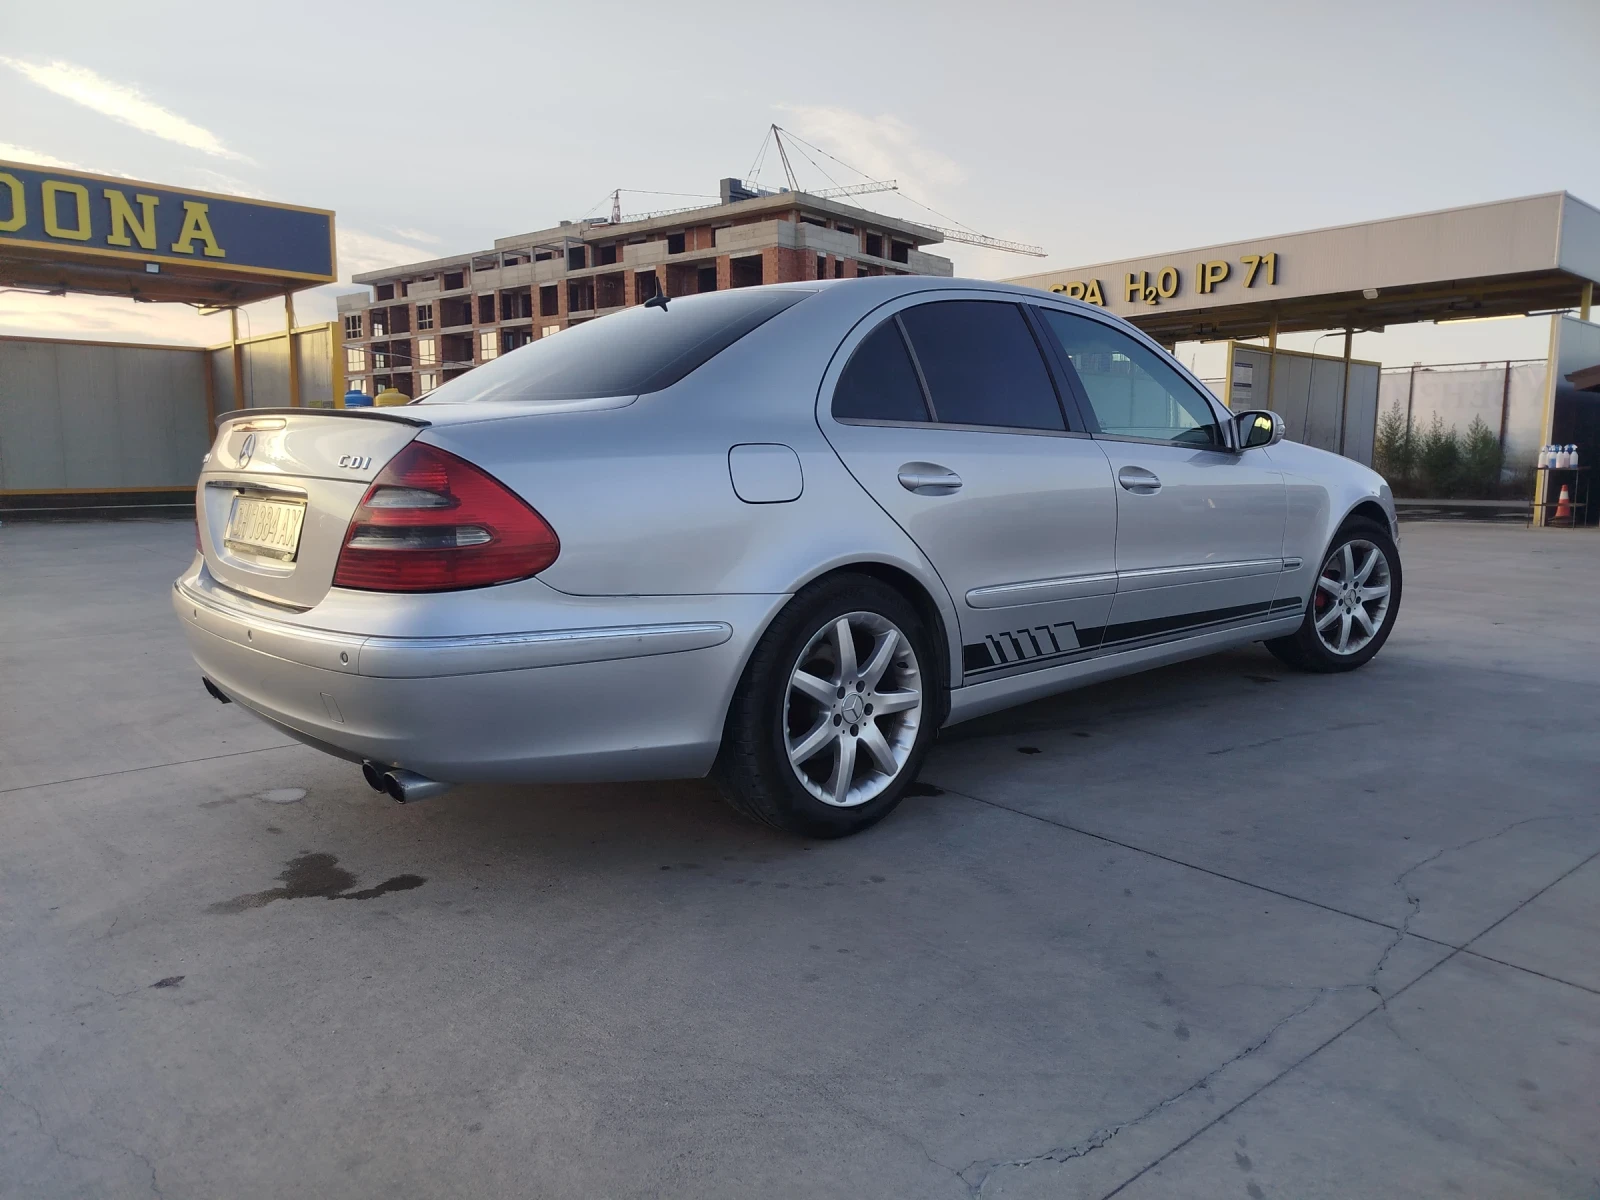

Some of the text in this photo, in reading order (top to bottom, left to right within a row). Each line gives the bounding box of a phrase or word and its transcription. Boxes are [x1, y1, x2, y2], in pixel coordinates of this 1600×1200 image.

[1049, 278, 1106, 307] PA
[1196, 260, 1231, 294] IP
[1240, 252, 1277, 289] 71
[337, 455, 372, 470] CDI
[249, 504, 281, 544] 1884
[276, 508, 302, 547] AX
